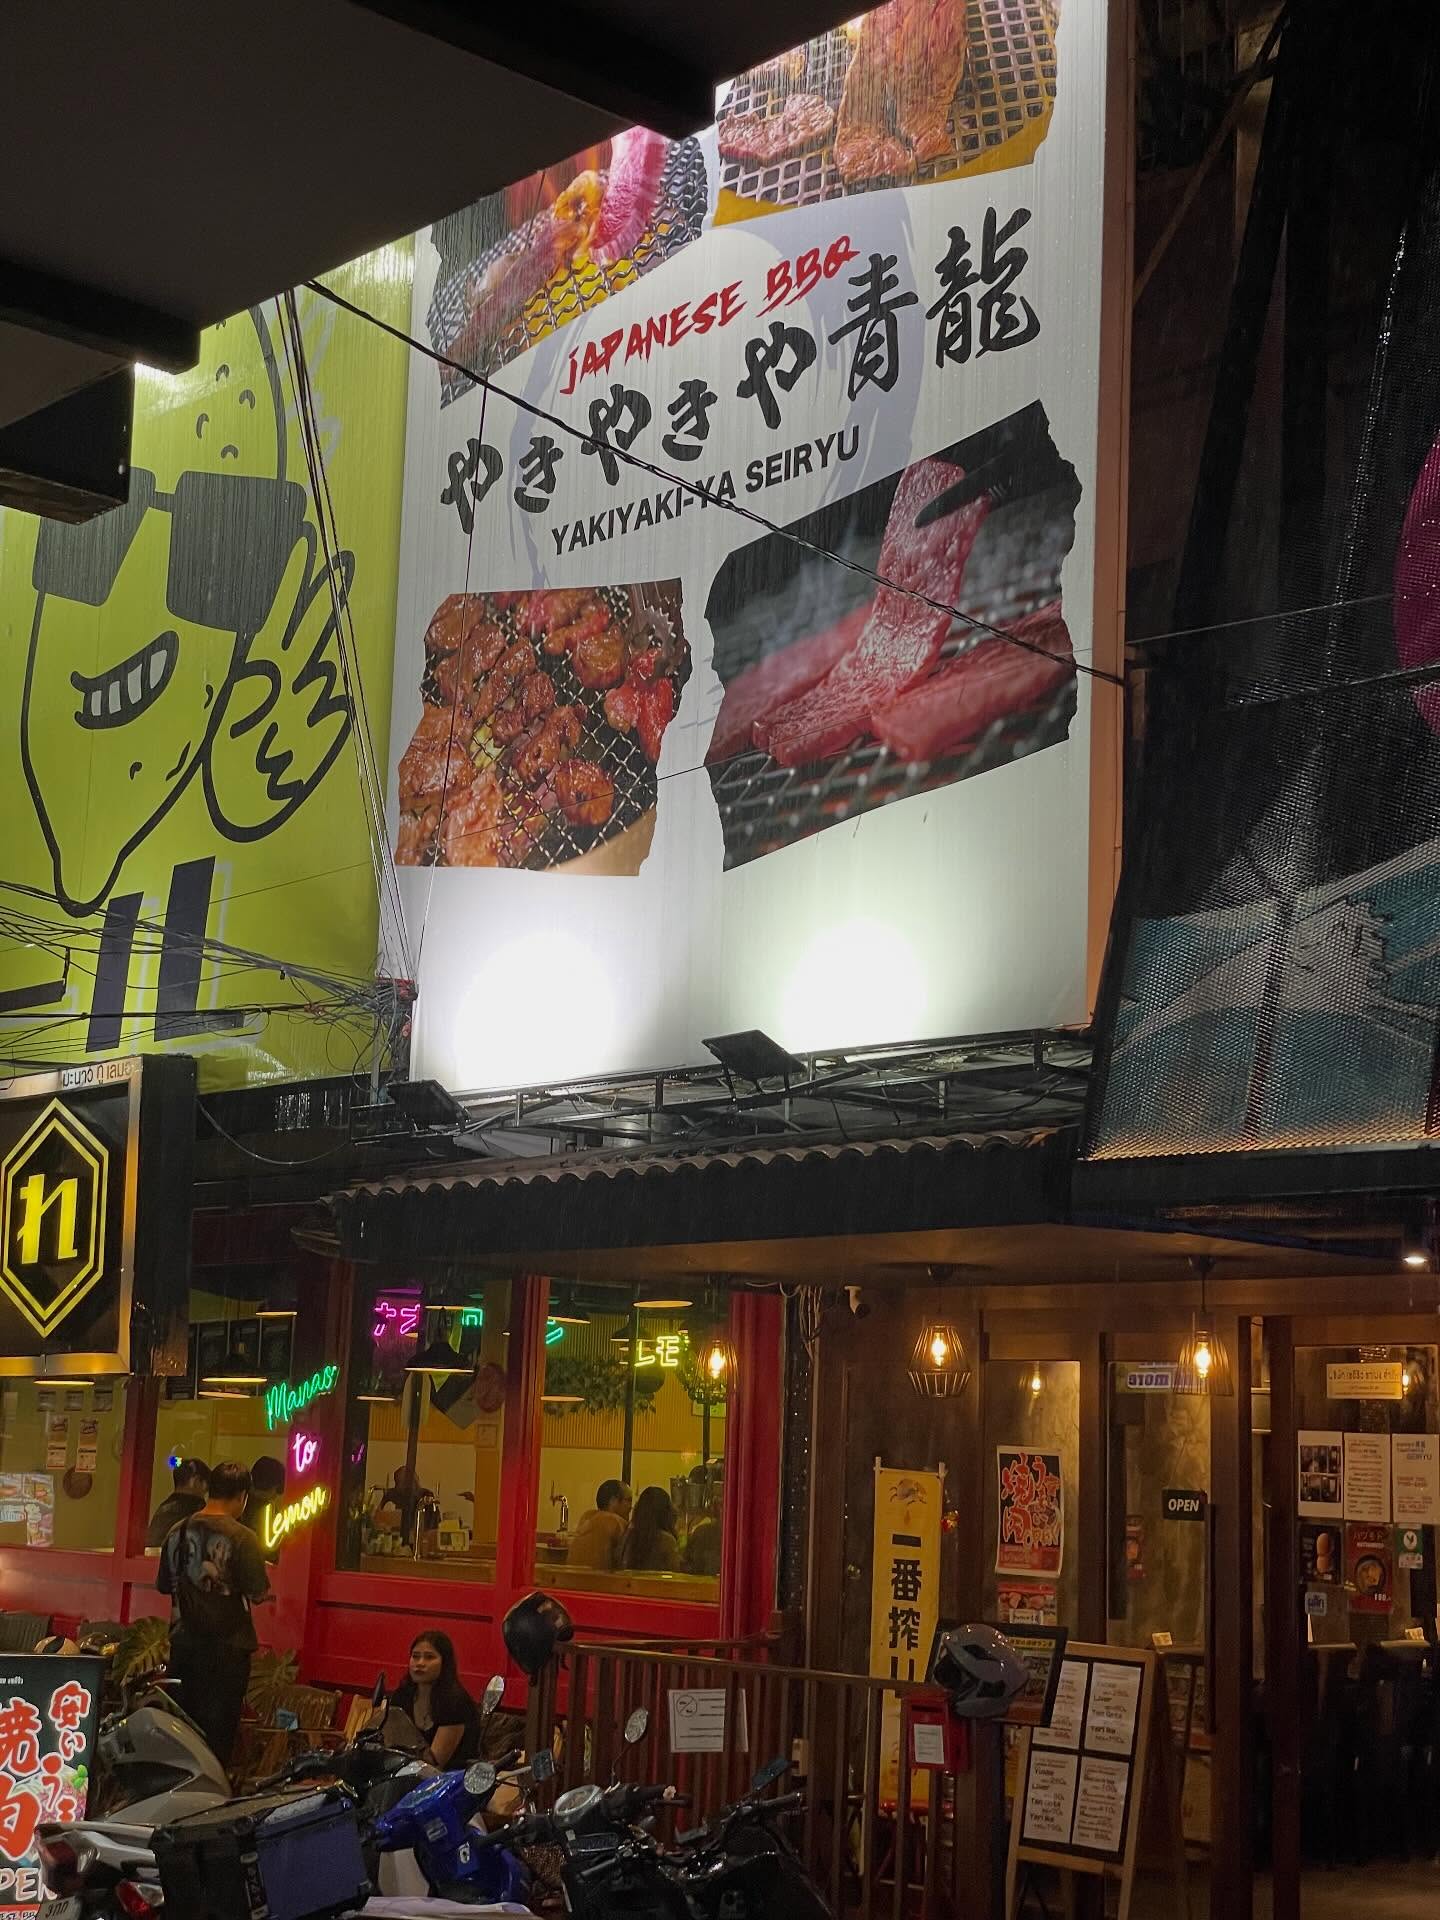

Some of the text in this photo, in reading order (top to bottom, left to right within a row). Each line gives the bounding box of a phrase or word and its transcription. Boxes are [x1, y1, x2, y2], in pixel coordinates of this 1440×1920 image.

[755, 235, 861, 318] BBQ
[551, 424, 861, 556] YAKIYAKI-YA SEIRYU
[292, 1432, 318, 1473] to
[263, 1486, 328, 1549] Lemon
[1168, 1498, 1200, 1513] OPEN
